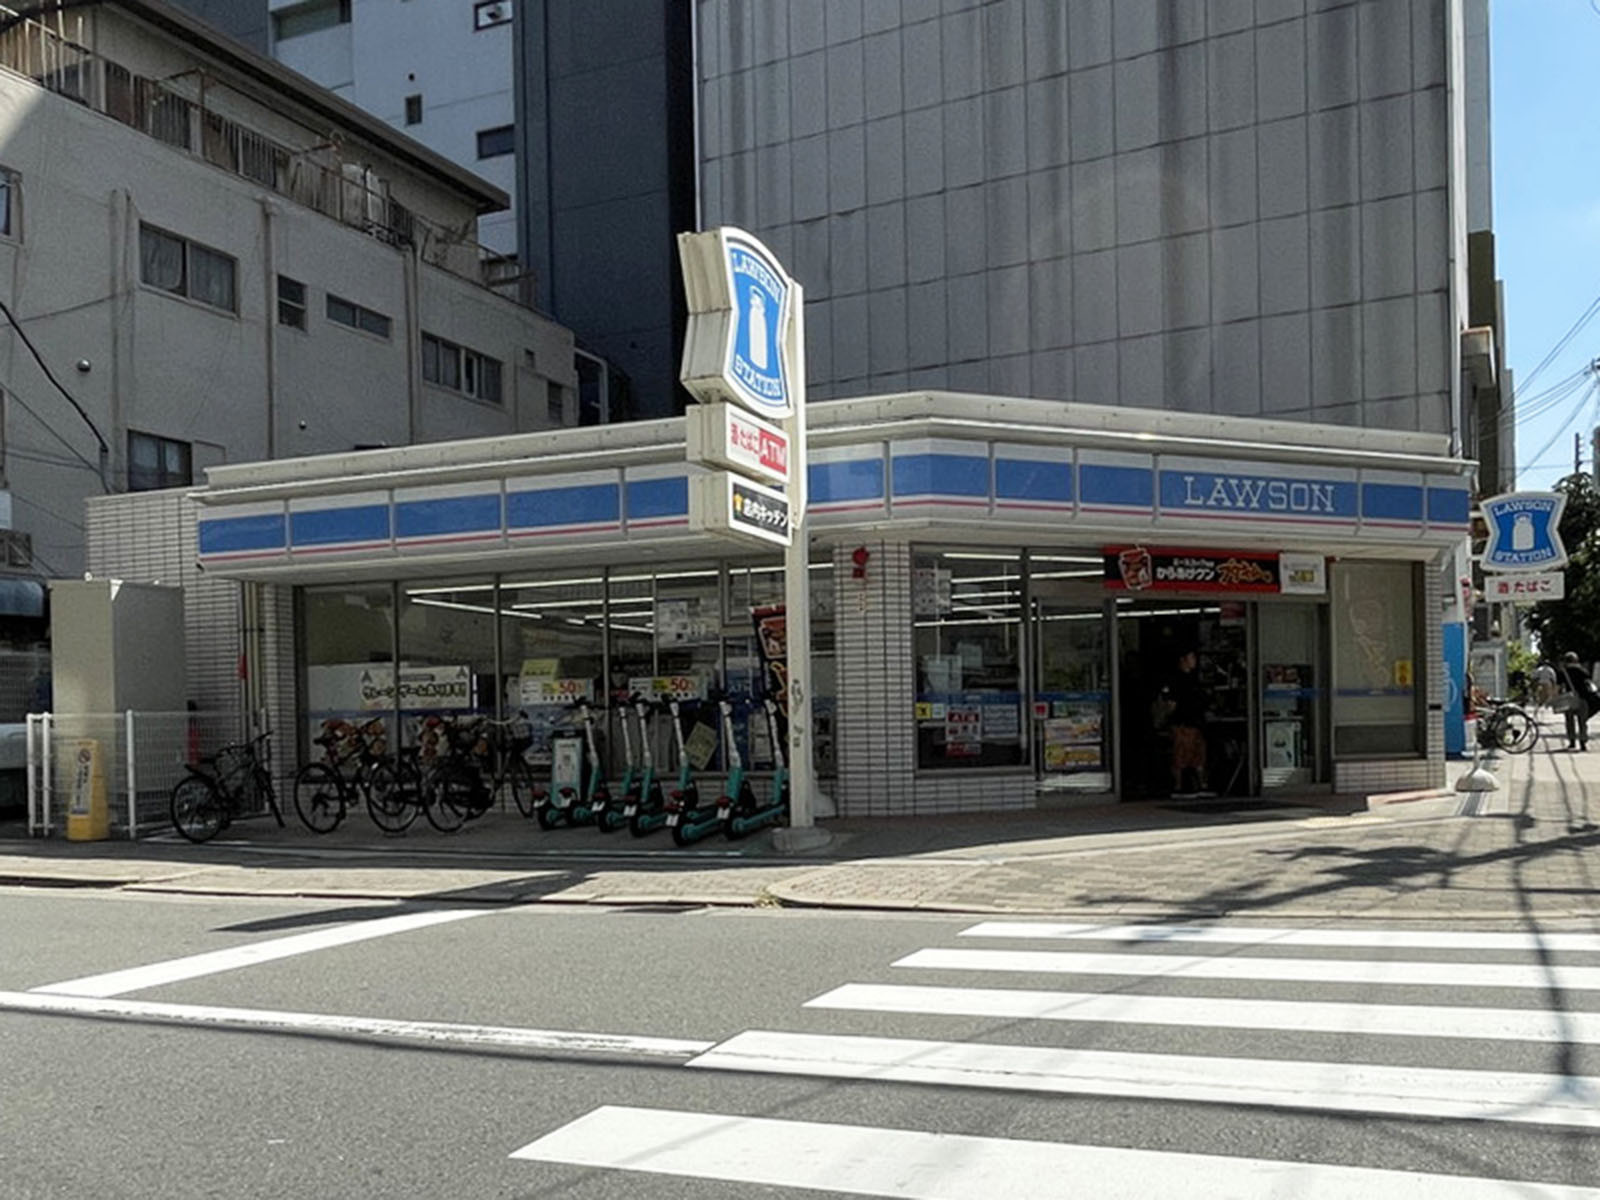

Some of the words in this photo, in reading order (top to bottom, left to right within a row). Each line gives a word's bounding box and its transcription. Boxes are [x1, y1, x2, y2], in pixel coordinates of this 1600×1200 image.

[732, 252, 781, 303] LAWSON
[734, 354, 782, 397] STATION
[760, 437, 787, 467] ATM
[1184, 476, 1334, 512] LAWSON
[1494, 501, 1554, 516] LAWSON
[1495, 547, 1553, 563] STATION
[1156, 566, 1215, 581] からあげクン
